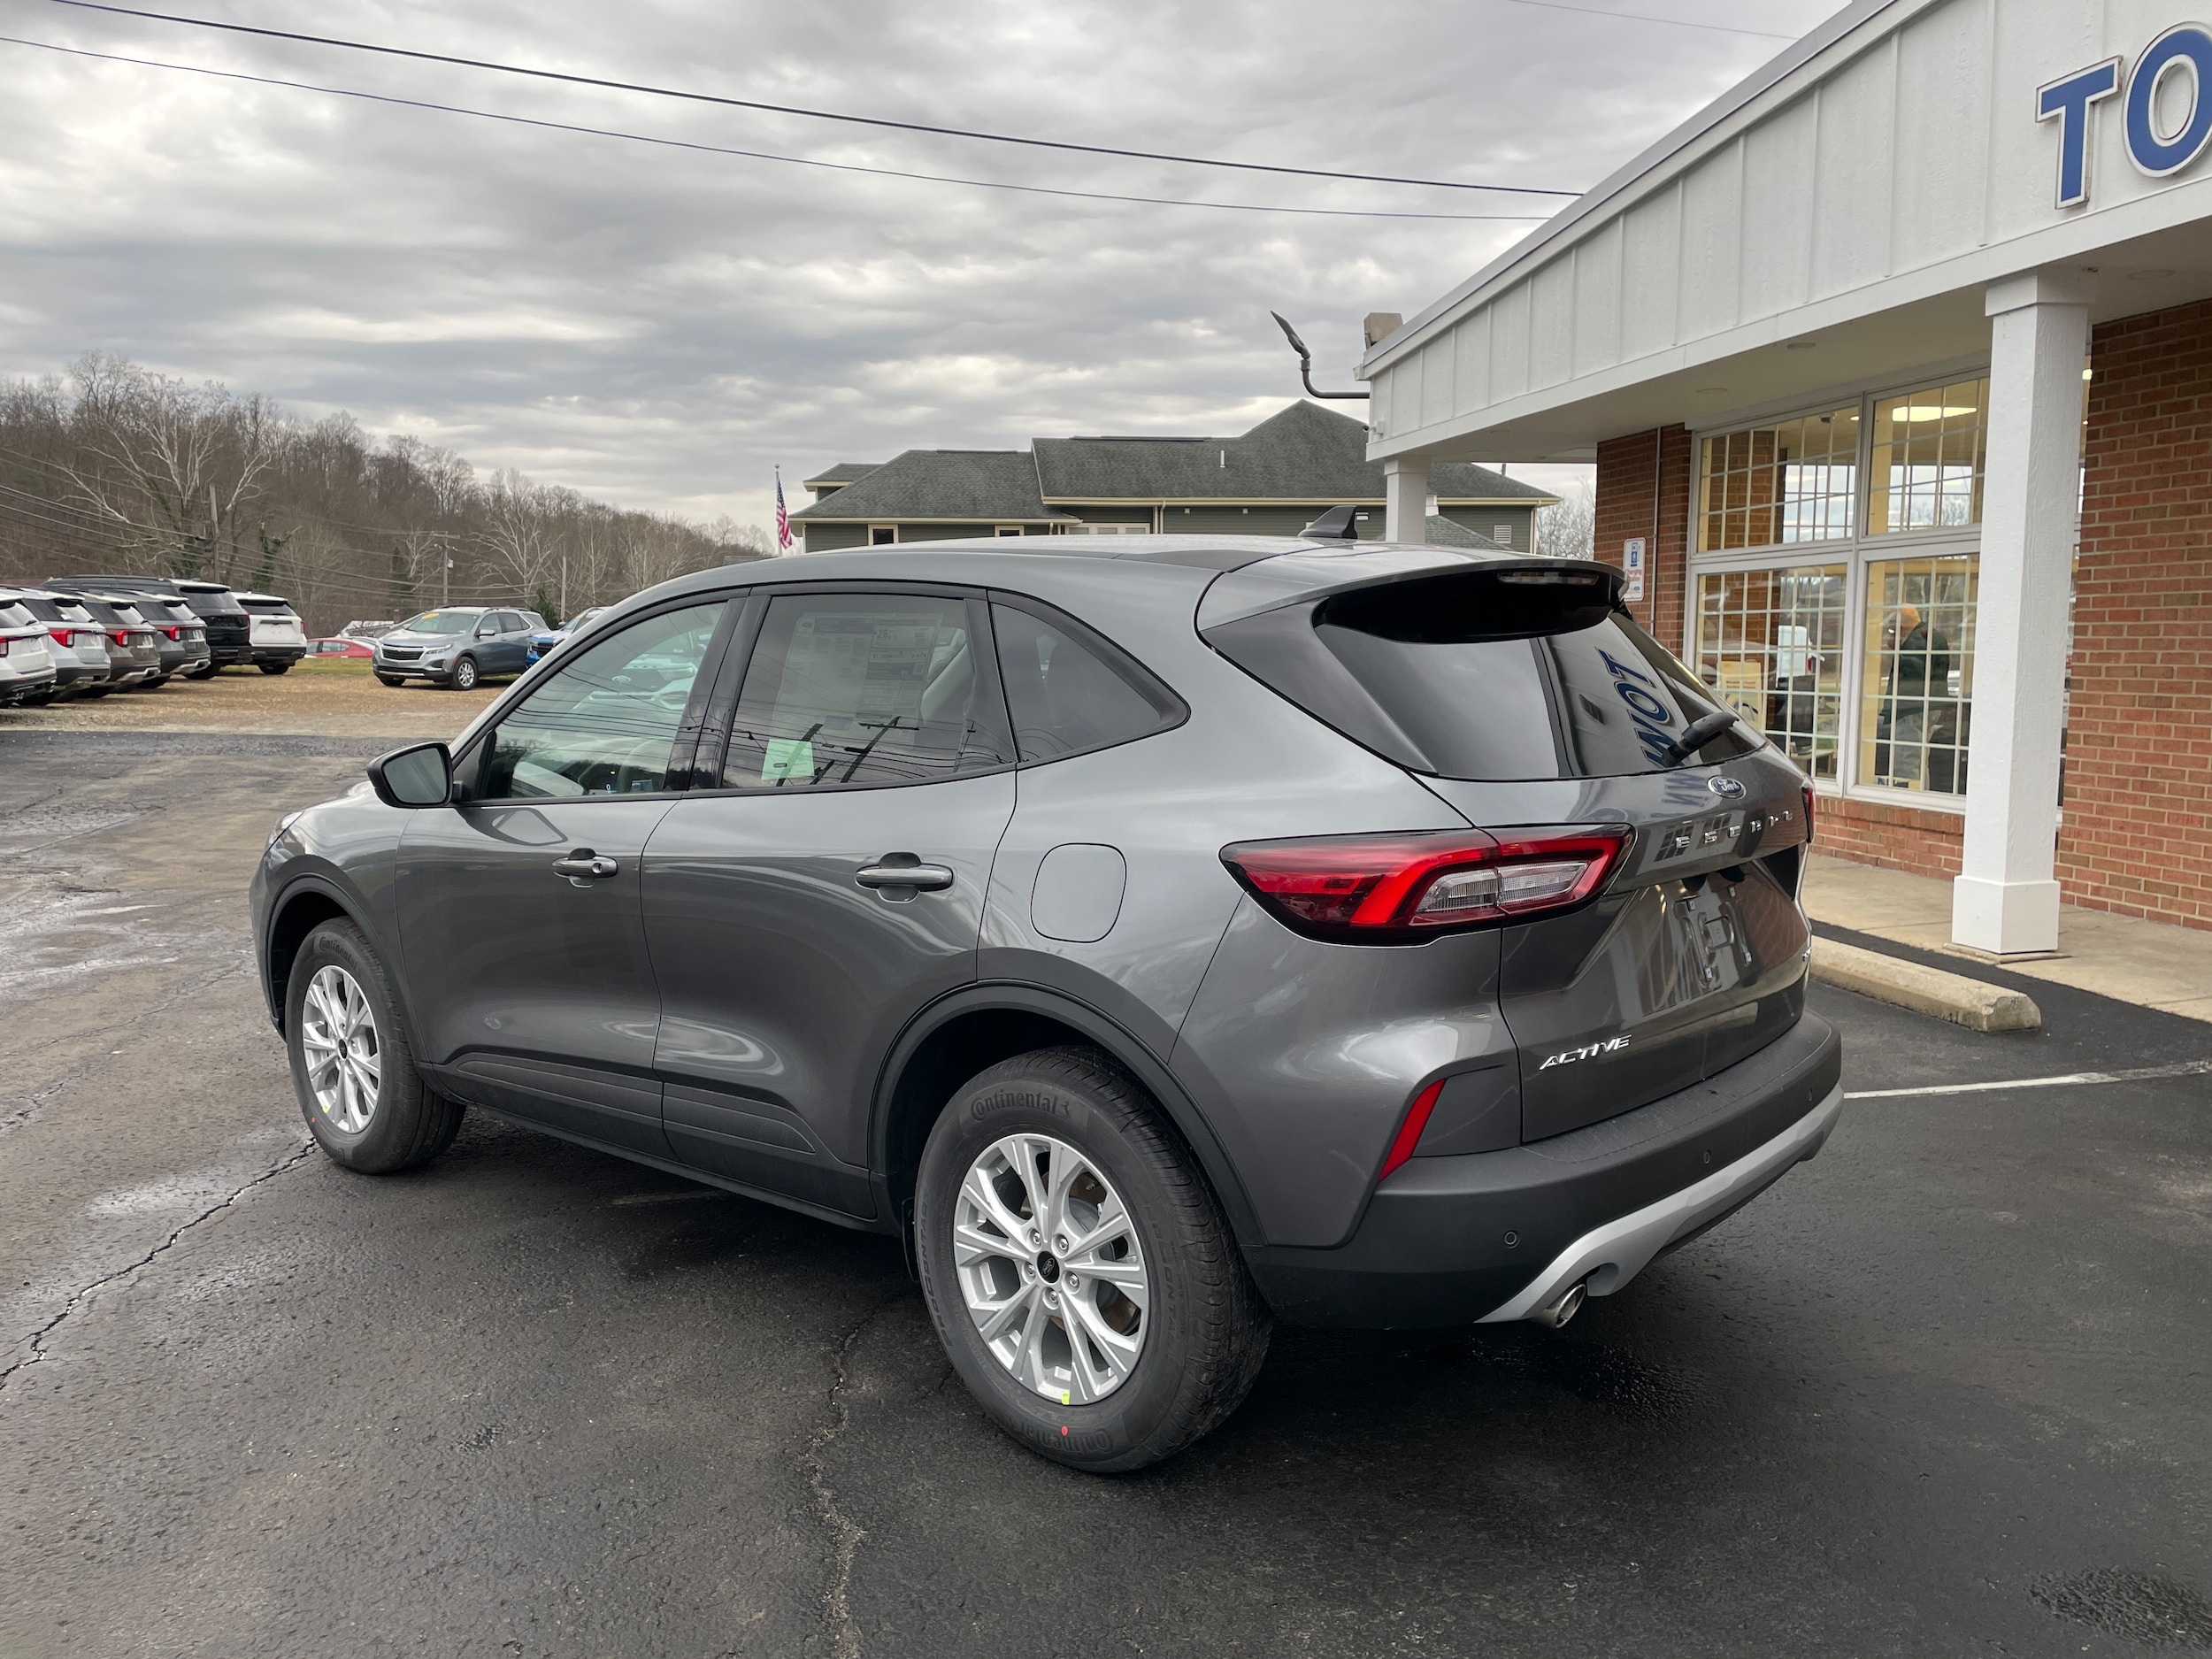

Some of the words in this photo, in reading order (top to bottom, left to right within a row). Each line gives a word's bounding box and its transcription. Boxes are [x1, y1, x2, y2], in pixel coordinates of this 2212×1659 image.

[2035, 21, 2212, 210] TO
[1539, 1034, 1632, 1070] ACTIVE
[970, 1088, 1058, 1121] Continental
